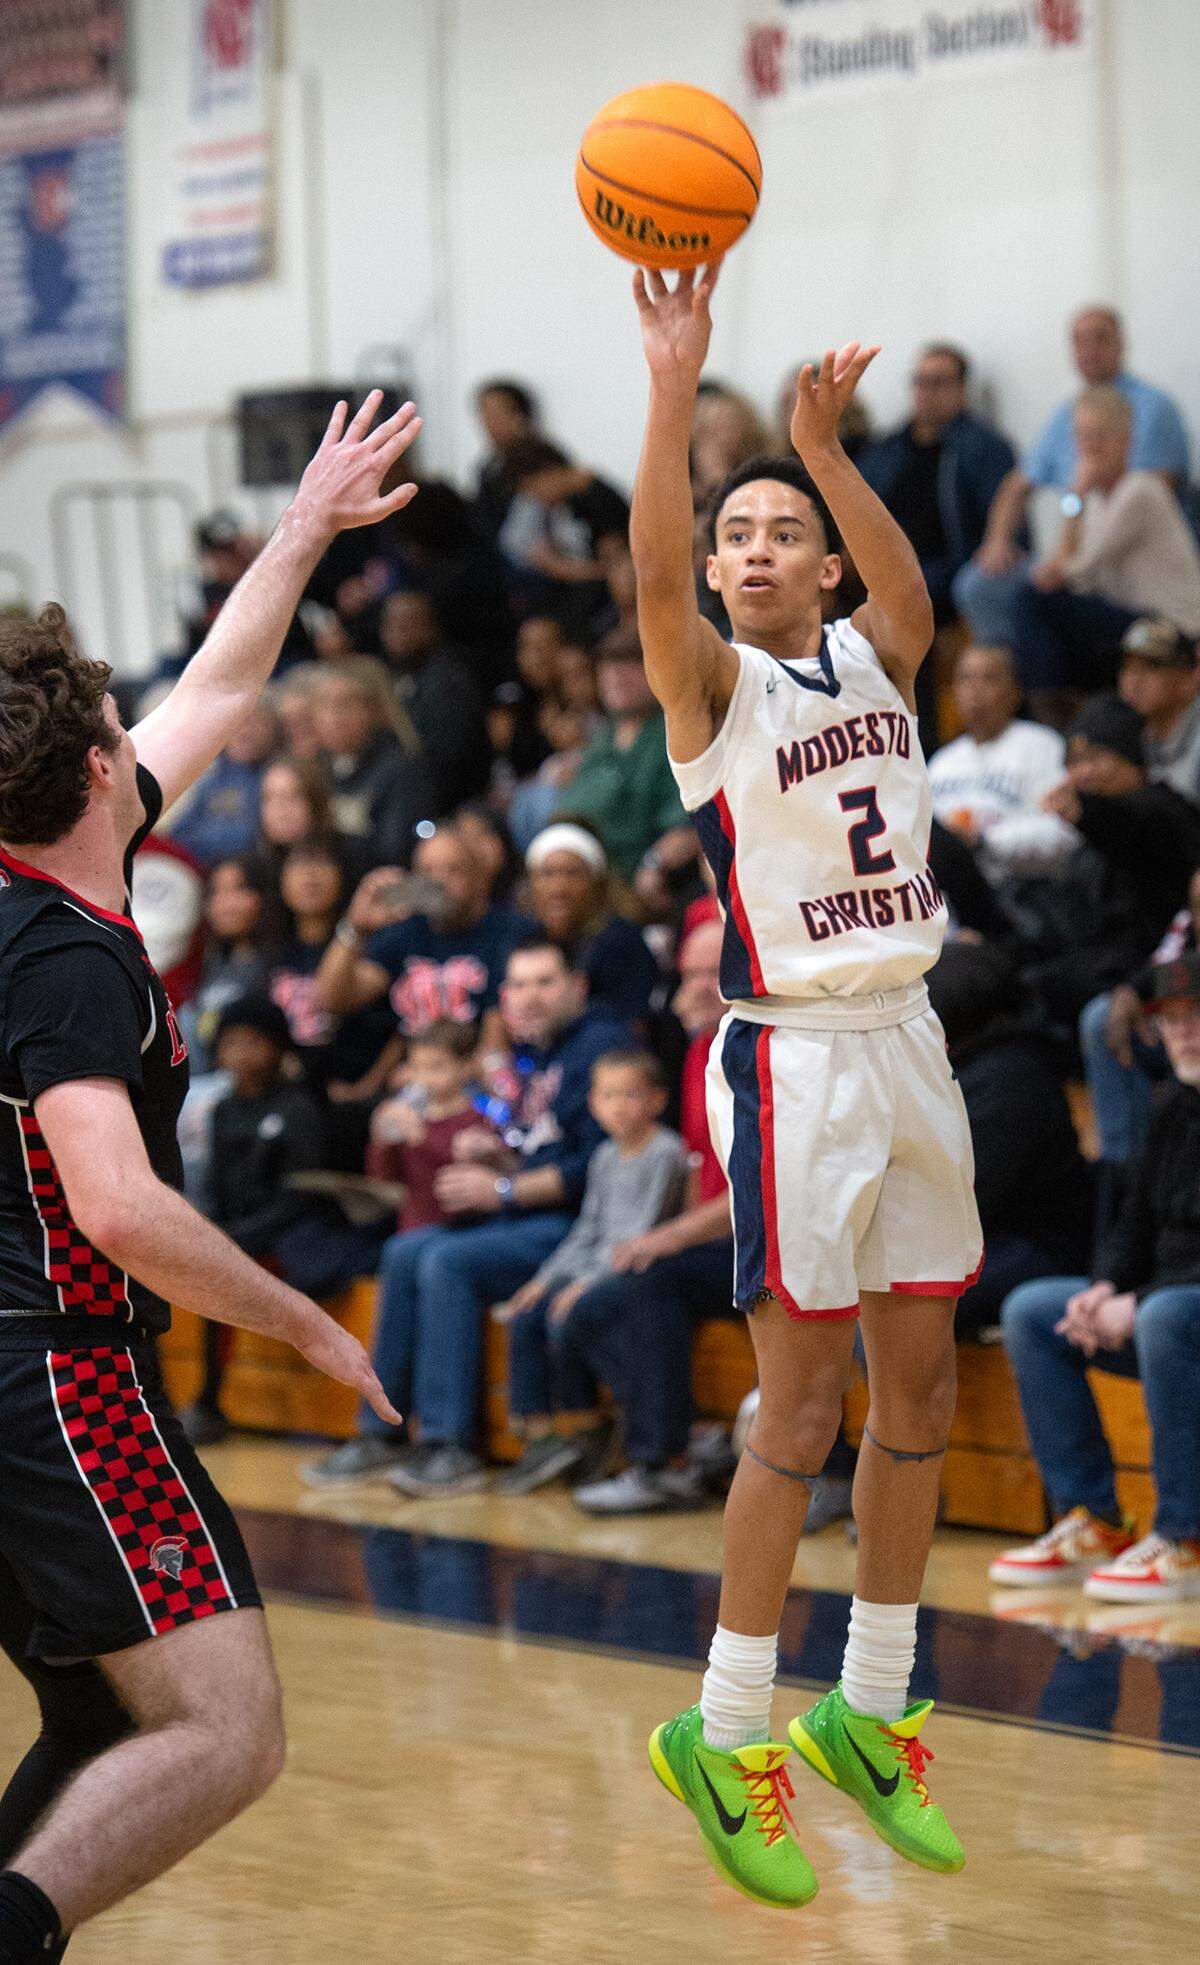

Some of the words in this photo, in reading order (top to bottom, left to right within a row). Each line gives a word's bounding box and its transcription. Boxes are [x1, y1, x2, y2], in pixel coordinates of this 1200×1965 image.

[595, 188, 710, 250] Wilson
[775, 711, 910, 794] MODESTO
[838, 785, 897, 877] 2
